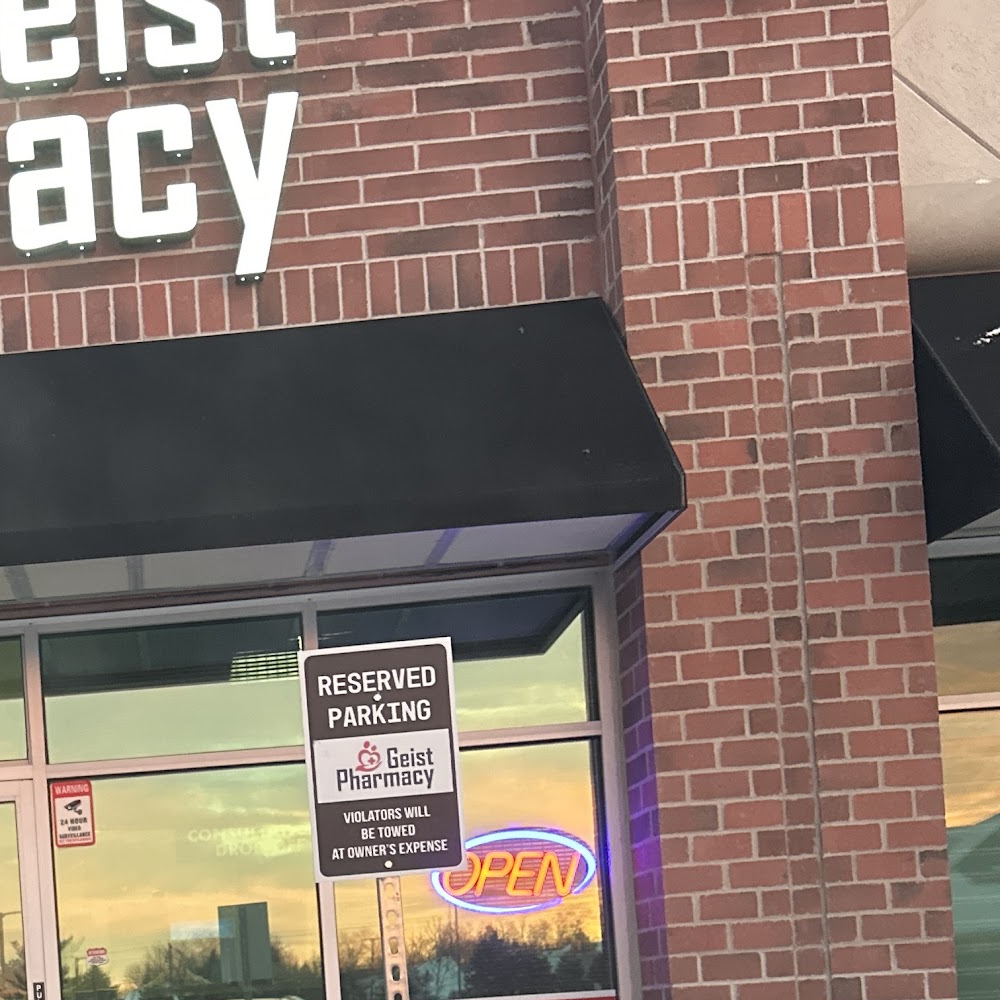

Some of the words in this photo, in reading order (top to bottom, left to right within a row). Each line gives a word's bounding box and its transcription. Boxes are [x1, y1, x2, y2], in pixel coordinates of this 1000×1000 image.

[317, 666, 436, 696] RESERVED
[328, 699, 431, 728] PARKING
[387, 747, 434, 769] Geist
[55, 784, 89, 795] WARNING
[336, 768, 435, 791] Pharmacy
[343, 807, 402, 824] VIOLATORS
[404, 805, 431, 819] WILL
[361, 827, 375, 840] BE
[377, 824, 416, 839] TOWED
[332, 847, 345, 860] AT
[347, 843, 396, 858] OWNER'S
[399, 839, 448, 854] EXPENSE
[442, 851, 581, 897] OPEN
